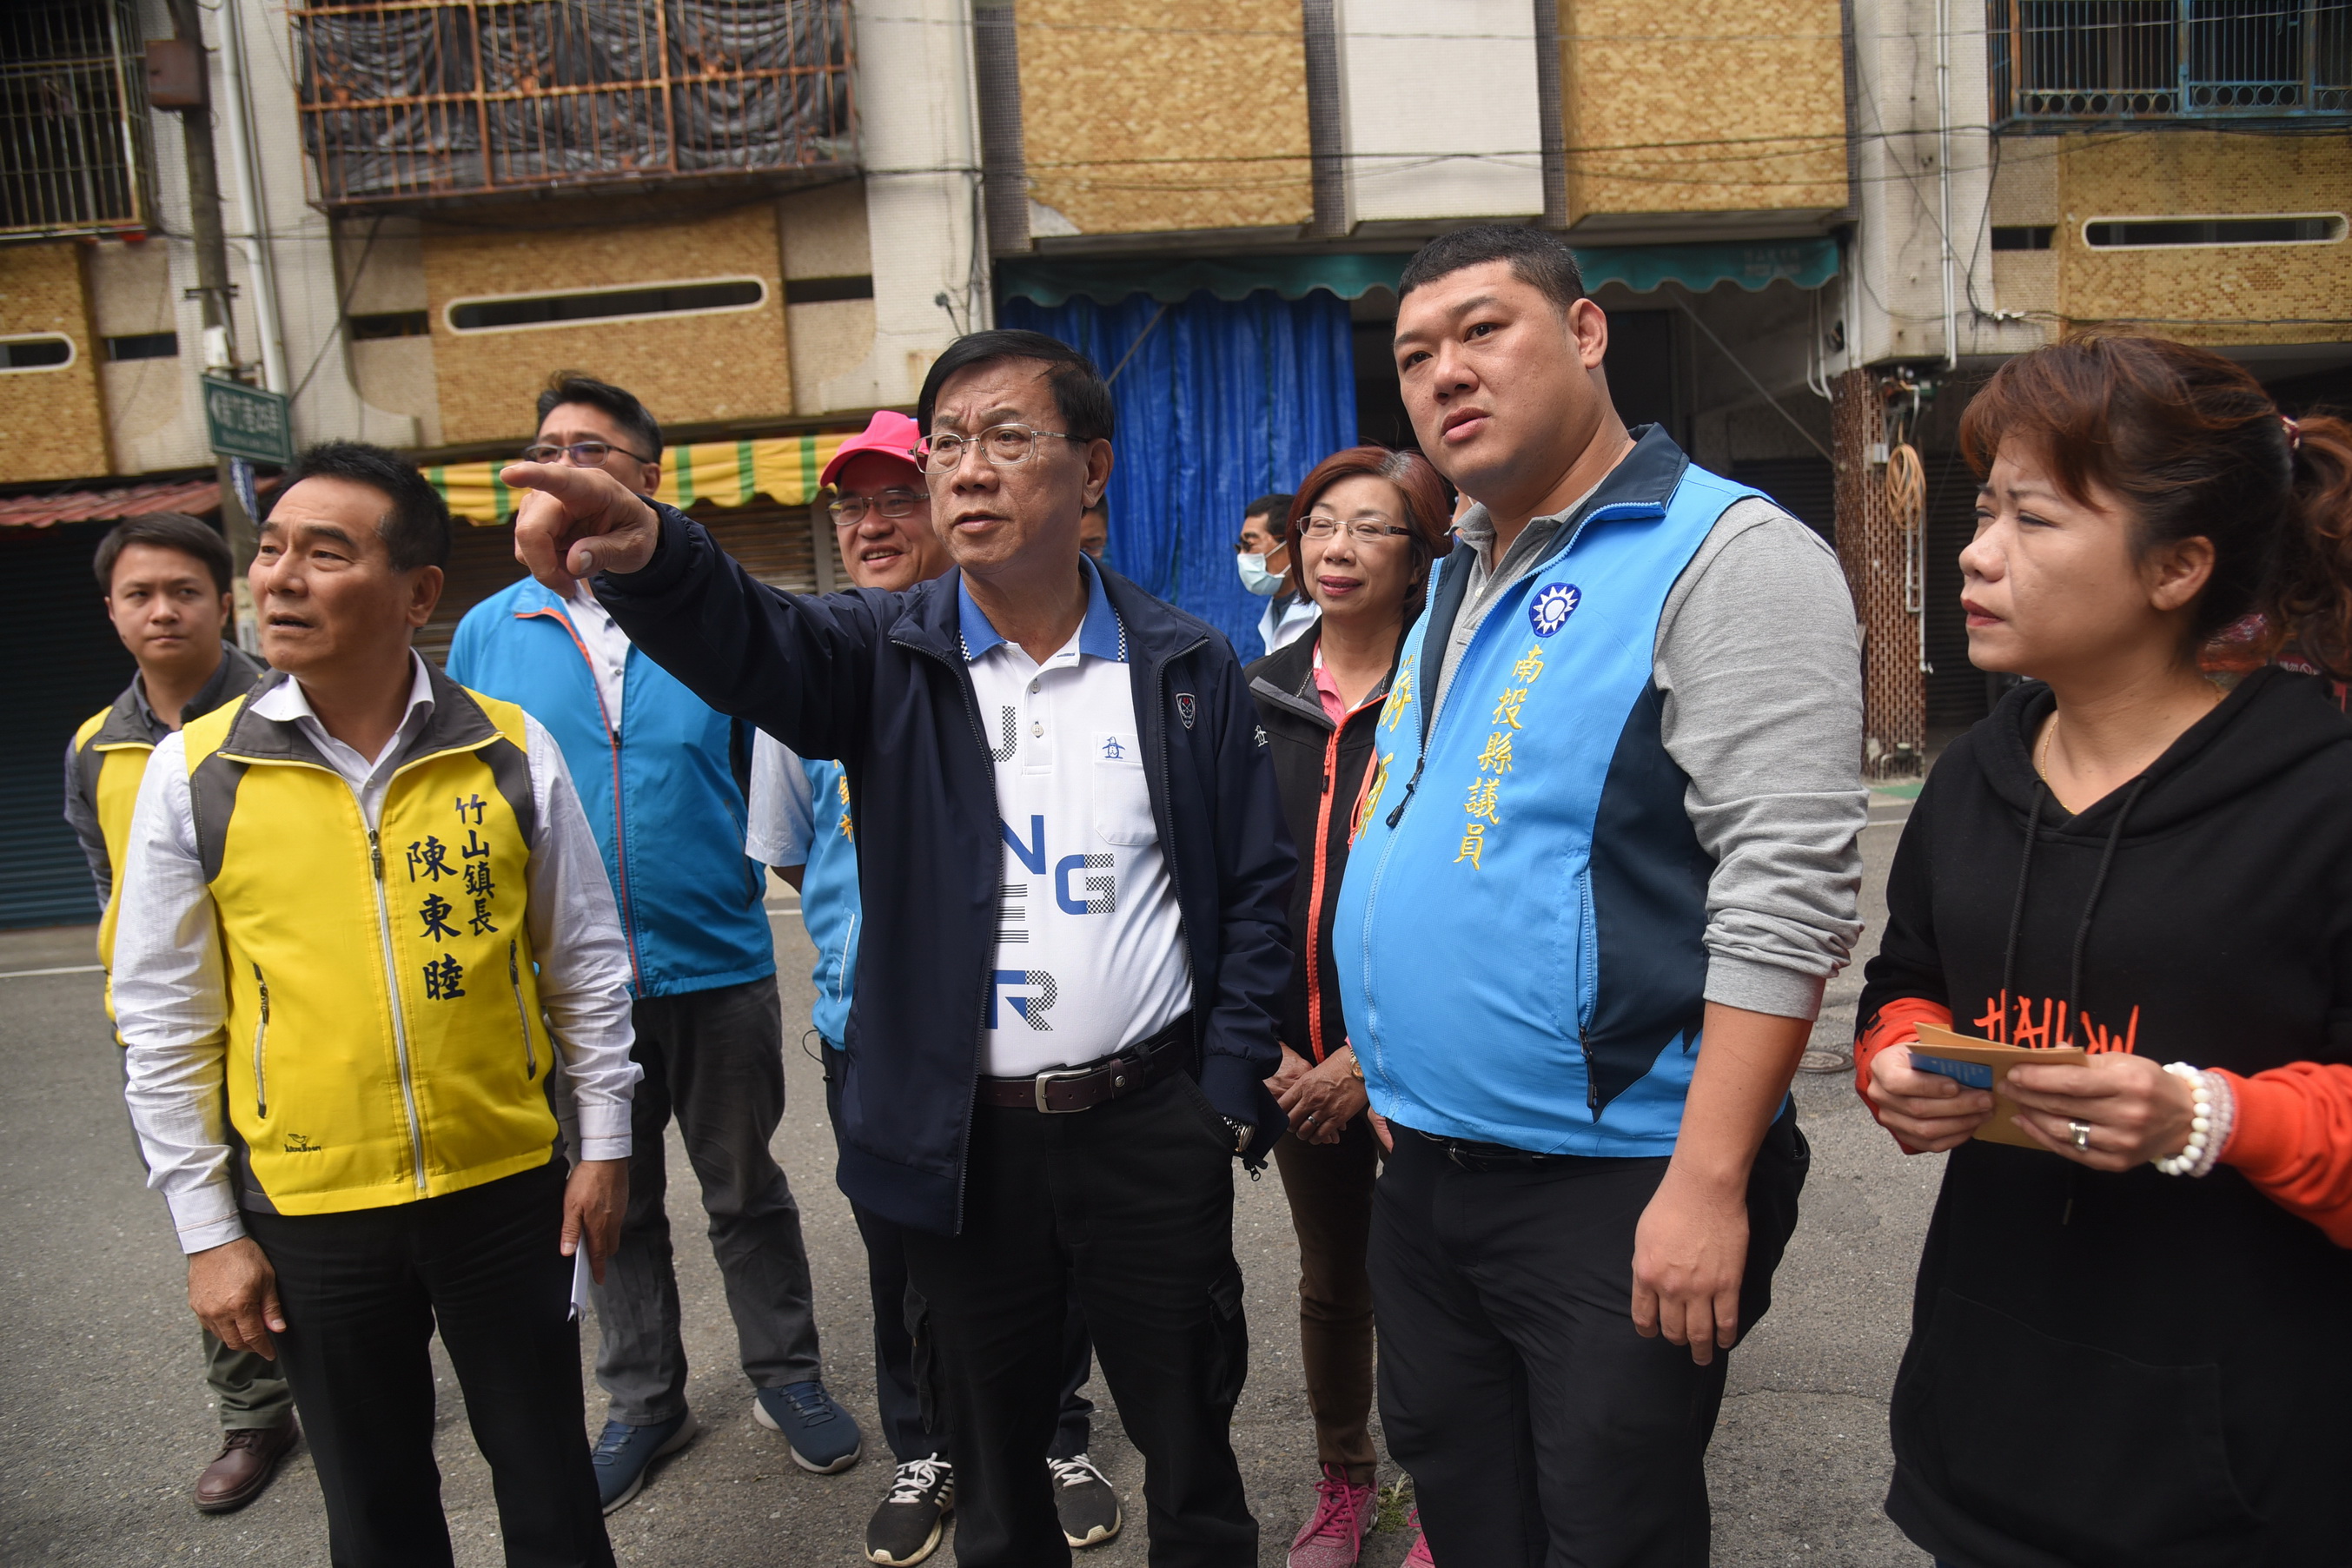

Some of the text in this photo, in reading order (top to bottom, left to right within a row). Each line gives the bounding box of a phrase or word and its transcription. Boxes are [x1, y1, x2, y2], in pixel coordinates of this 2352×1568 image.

[1453, 644, 1545, 871] 南投縣議員
[406, 835, 466, 1001] 陳東睦
[455, 793, 499, 936] 竹山鎮長
